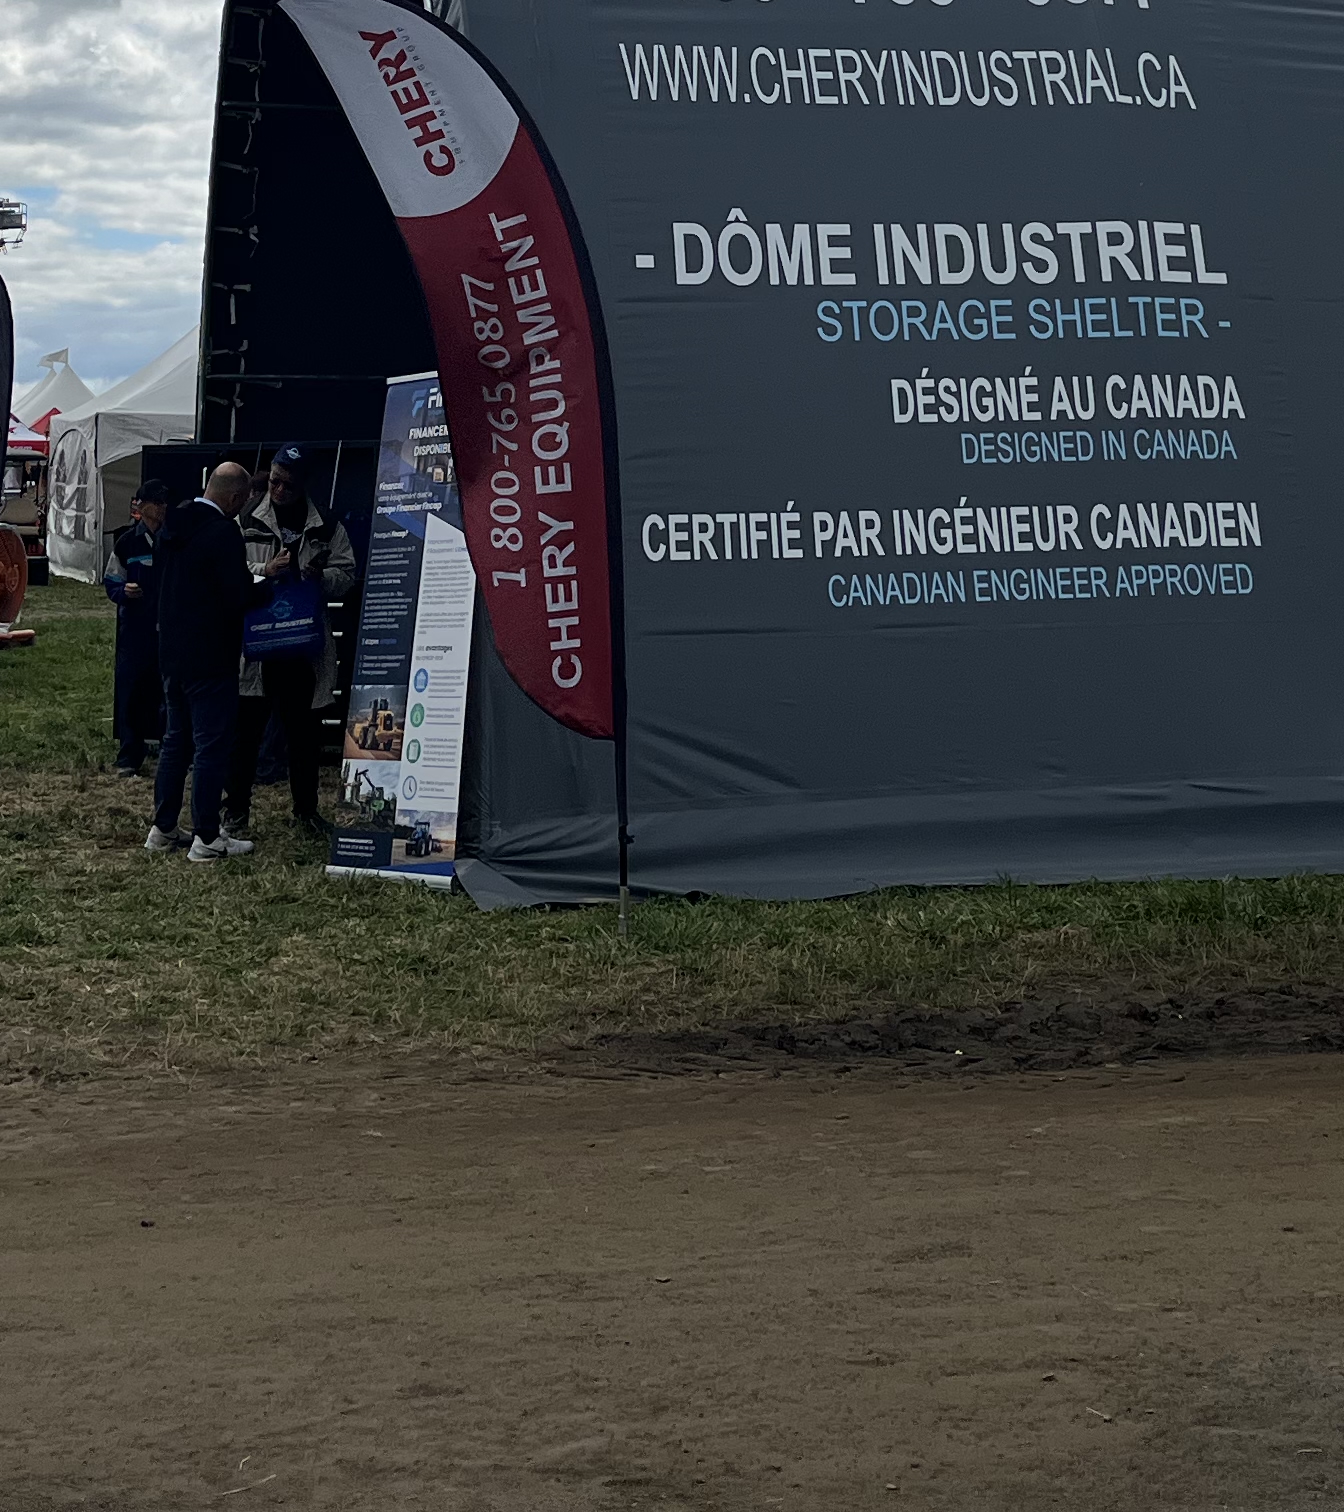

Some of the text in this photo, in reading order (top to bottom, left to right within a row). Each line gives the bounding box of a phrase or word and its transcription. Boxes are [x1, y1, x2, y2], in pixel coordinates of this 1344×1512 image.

[358, 29, 456, 177] CHERY
[618, 43, 1197, 110] WWW.CHERYINDUSTRIAL.CA
[673, 207, 856, 287] DÔME
[873, 219, 1228, 286] INDUSTRIEL
[817, 299, 1017, 343] STORAGE
[1027, 297, 1210, 340] SHELTER
[890, 365, 1245, 424] DÉSIGNÉ AU CANADA
[461, 272, 528, 590] 1 800-765-0877
[490, 212, 585, 690] CHERY EQUIPMENT
[960, 429, 1237, 465] DESIGNED IN CANADA
[642, 497, 1262, 563] CERTIFIÉ PAR INGÉNIEUR CANADIEN
[827, 563, 1254, 608] CANADIAN ENGINEER APPROVED
